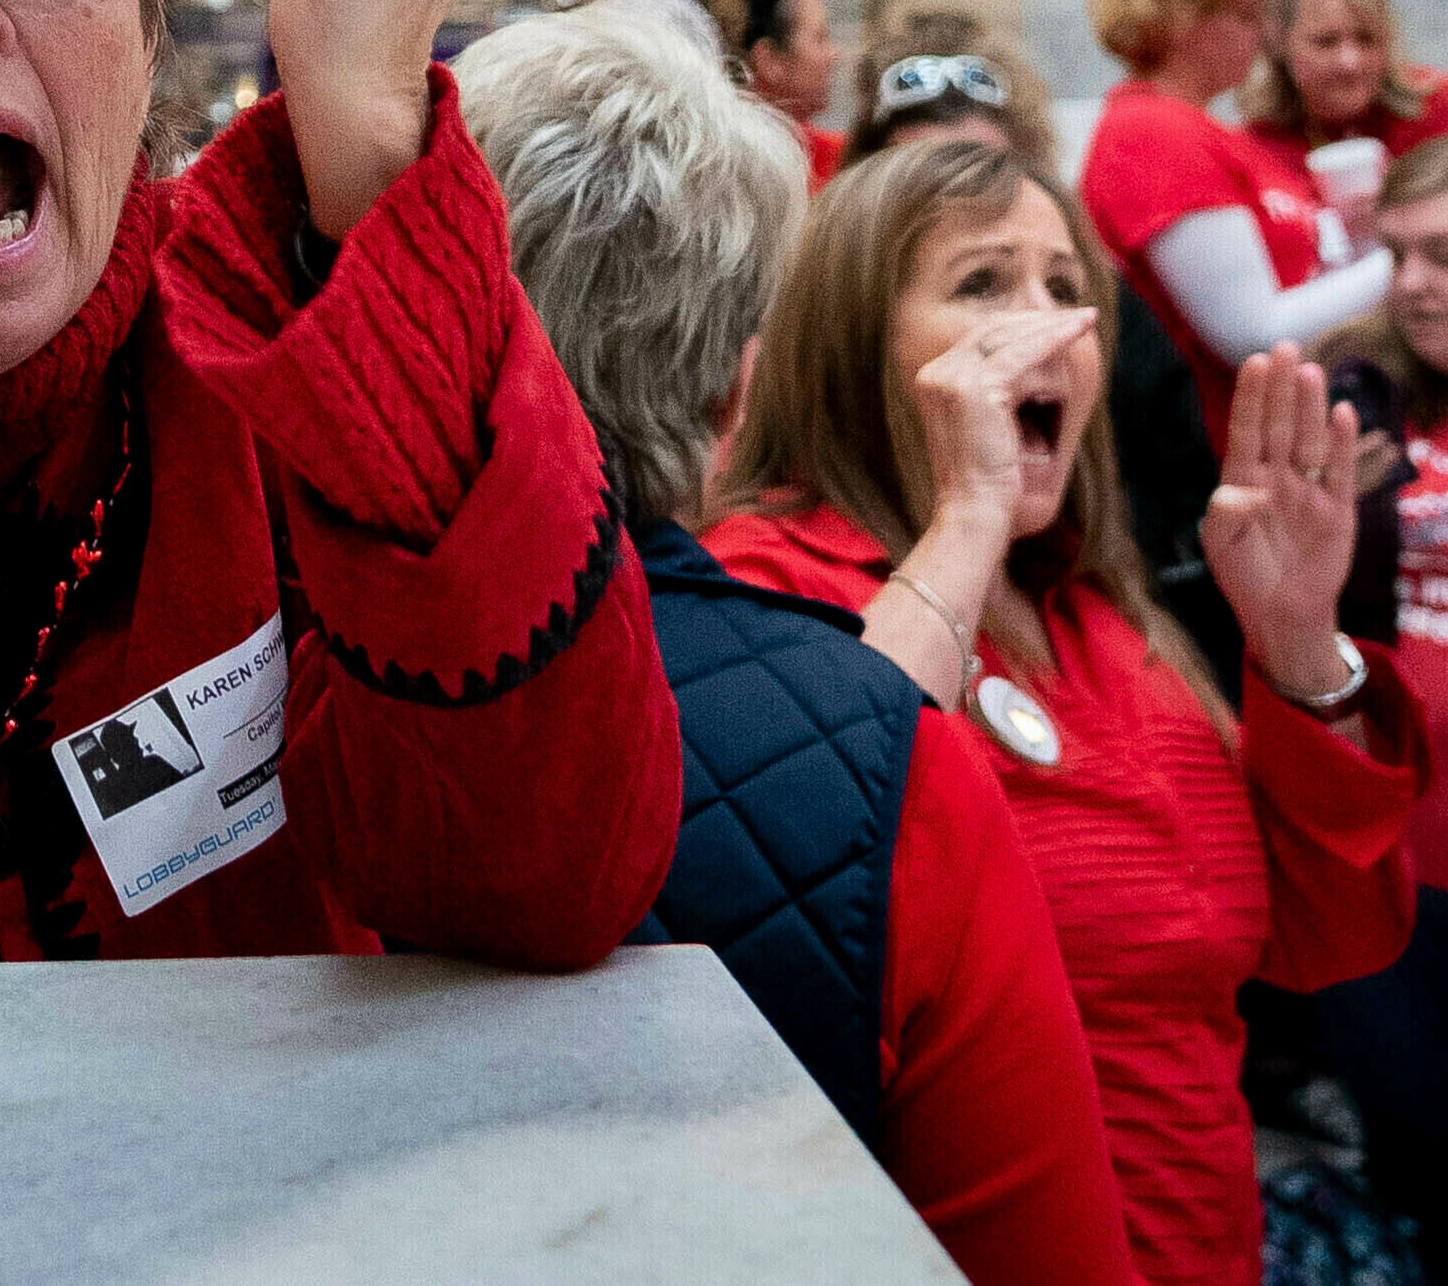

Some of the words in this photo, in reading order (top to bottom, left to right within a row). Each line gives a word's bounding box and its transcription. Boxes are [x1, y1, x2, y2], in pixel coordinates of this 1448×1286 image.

[186, 662, 252, 710] KAREN
[248, 703, 281, 741] Capitol
[124, 801, 276, 899] LOBBYGUARD
